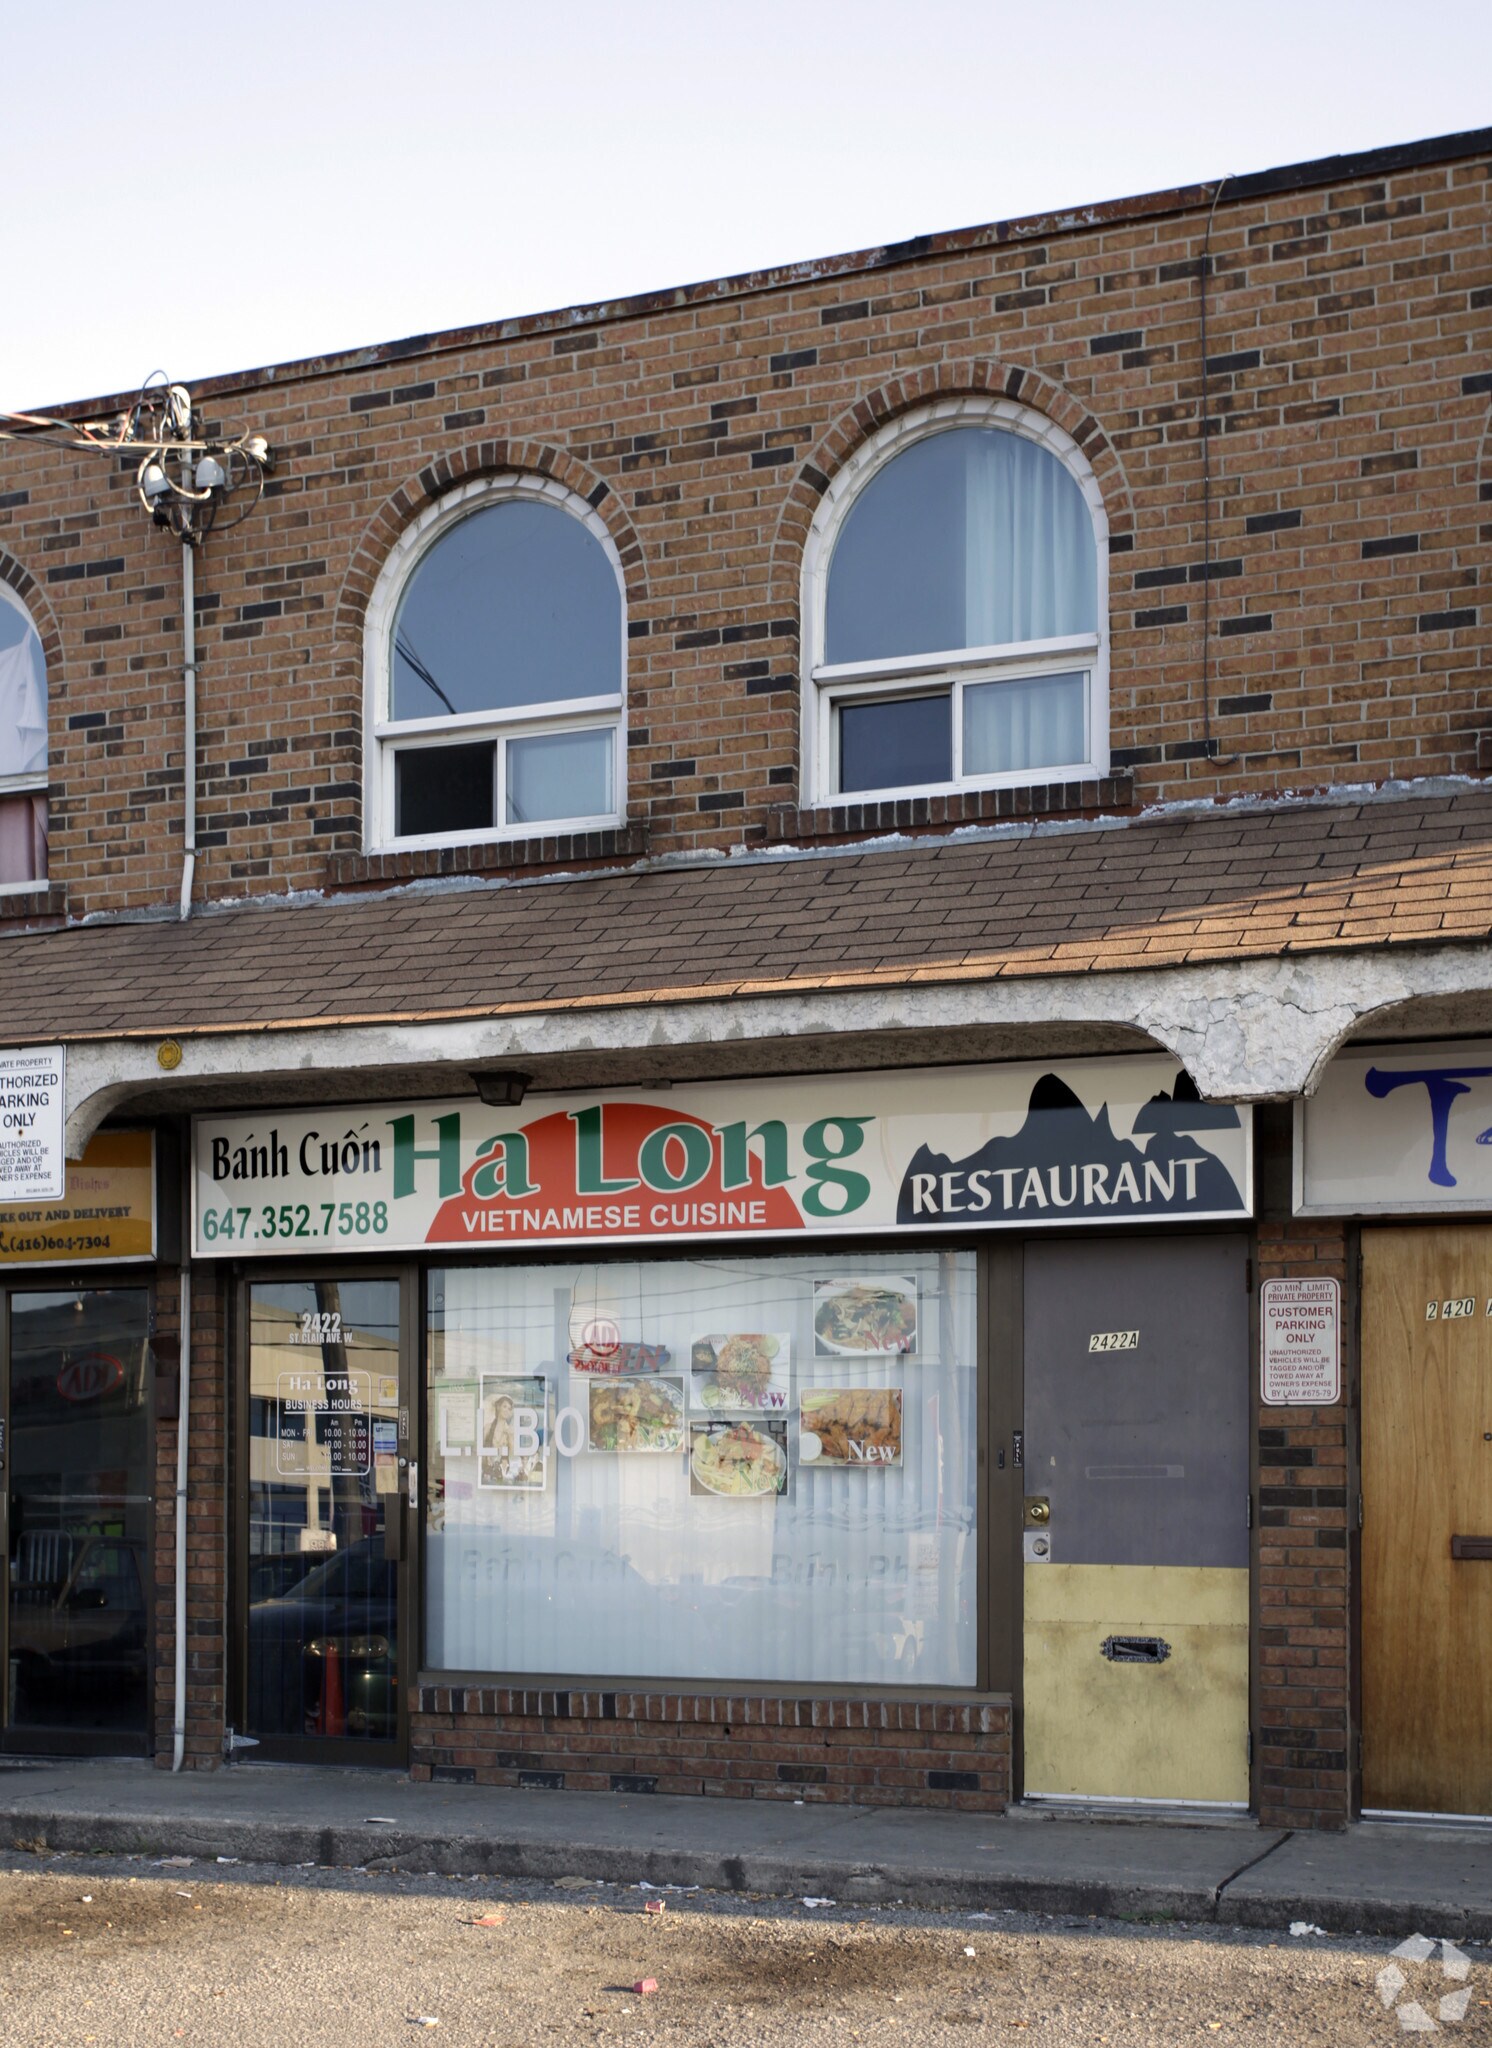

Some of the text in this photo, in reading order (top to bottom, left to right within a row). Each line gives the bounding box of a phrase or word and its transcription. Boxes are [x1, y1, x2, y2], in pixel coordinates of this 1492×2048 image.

[16, 1057, 53, 1067] PROPERTY
[0, 1073, 58, 1089] THORIZED
[0, 1092, 49, 1108] ARKING
[3, 1112, 36, 1128] ONLY
[1365, 1066, 1492, 1187] T
[23, 1148, 38, 1156] WILL
[40, 1147, 49, 1155] BE
[211, 1129, 290, 1181] Bánh
[385, 1105, 876, 1218] Ha Long
[20, 1171, 52, 1180] EXPENSE
[909, 1156, 1208, 1215] RESTAURANT
[18, 1211, 42, 1222] OUT
[45, 1209, 70, 1221] AND
[73, 1206, 131, 1220] DELIVERY
[203, 1200, 388, 1241] 647.352.7588
[461, 1200, 766, 1233] VIETNAMESE CUISINE
[1272, 1284, 1282, 1292] 30
[1307, 1283, 1330, 1291] LIMIT
[1298, 1292, 1333, 1300] PROPERTY
[1268, 1307, 1333, 1317] CUSTOMER
[302, 1312, 341, 1333] 2422
[1276, 1320, 1326, 1330] PARKING
[301, 1332, 325, 1344] CLAIR
[326, 1332, 342, 1344] AVE.
[864, 1330, 913, 1351] New
[1090, 1332, 1137, 1351] 2422A
[1286, 1333, 1315, 1343] ONLY
[290, 1376, 359, 1395] Ha Long
[285, 1399, 362, 1410] BUSINESS HOURS
[739, 1385, 787, 1408] New
[281, 1428, 296, 1437] MON
[324, 1428, 342, 1437] 10.00
[348, 1428, 367, 1437] 10.00
[282, 1441, 294, 1449] SAT
[324, 1441, 342, 1449] 10.00
[348, 1441, 367, 1449] 10.00
[848, 1440, 896, 1462] New
[282, 1452, 295, 1461] SUN
[348, 1452, 367, 1461] 10.00
[738, 1471, 787, 1493] New
